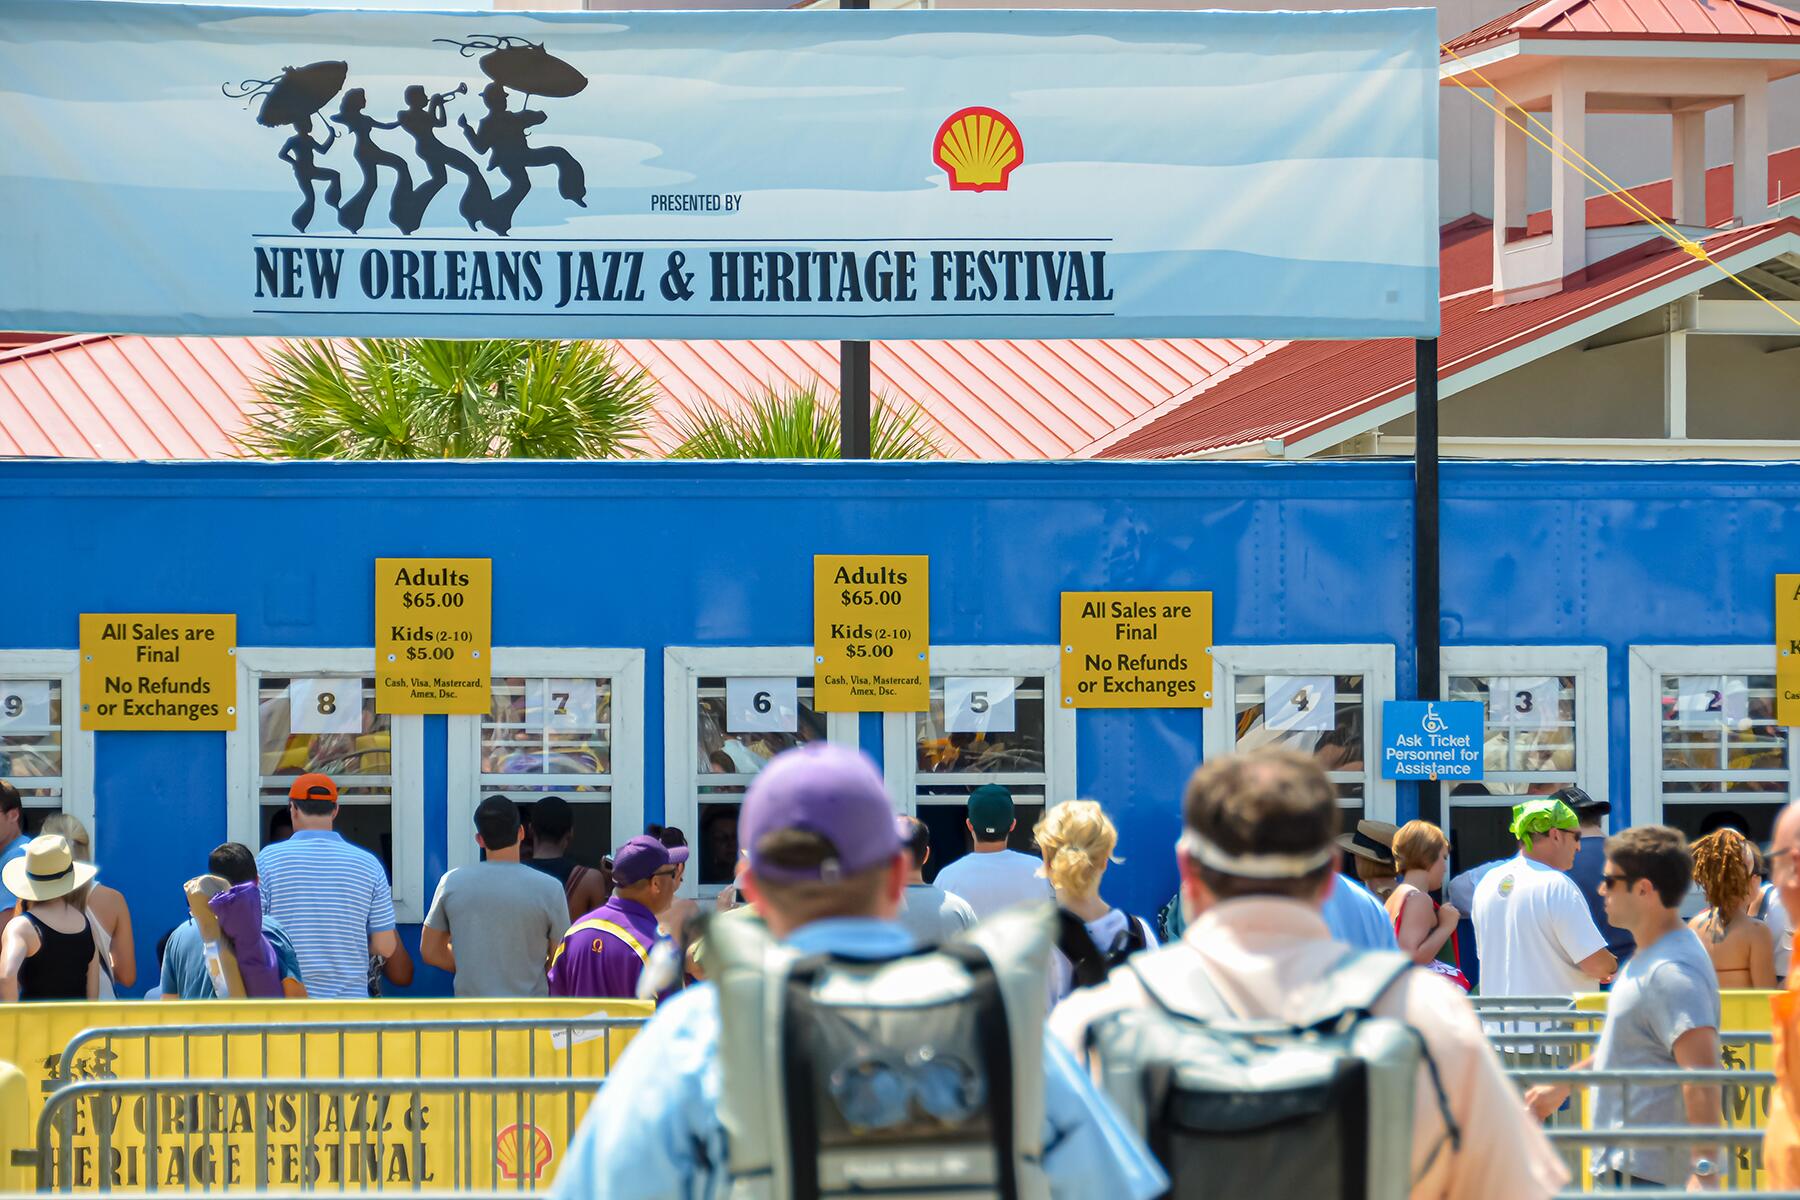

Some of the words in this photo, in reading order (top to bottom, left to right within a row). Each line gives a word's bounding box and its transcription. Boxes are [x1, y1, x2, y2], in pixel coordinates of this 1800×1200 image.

[651, 194, 721, 212] PRESENTED
[725, 194, 743, 212] BY
[254, 246, 345, 300] NEW
[360, 249, 543, 302] ORLEANS
[555, 251, 645, 309] JAZZ
[660, 250, 695, 302] &
[709, 251, 917, 303] HERITAGE
[931, 250, 1114, 302] FESTIVAL
[394, 567, 470, 587] Adults
[833, 566, 908, 585] Adults
[402, 591, 464, 609] $65.00
[841, 589, 902, 607] $65.00
[1081, 601, 1106, 618] All
[1111, 601, 1157, 618] Sales
[1162, 606, 1192, 618] are
[101, 623, 127, 641] All
[132, 623, 179, 641] Sales
[184, 628, 215, 641] are
[391, 626, 434, 642] Kids
[435, 630, 473, 643] (2-10)
[831, 624, 873, 640] Kids
[874, 628, 912, 641] (2-10)
[1115, 623, 1157, 640] Final
[136, 645, 180, 662] Final
[406, 646, 455, 662] $5.00
[846, 643, 894, 659] $5.00
[1085, 654, 1112, 671] No
[1117, 653, 1188, 671] Refunds
[105, 676, 133, 694] No
[138, 676, 211, 694] Refunds
[384, 677, 409, 689] Cash,
[411, 677, 432, 689] Visa,
[434, 677, 483, 690] Mastercard,
[824, 675, 849, 686] Cash,
[850, 675, 871, 686] Visa,
[873, 675, 922, 686] Mastercard,
[1077, 680, 1098, 693] or
[1103, 675, 1196, 698] Exchanges
[410, 689, 437, 699] Amex,
[850, 686, 877, 697] Amex,
[1290, 689, 1310, 712] 4
[4, 695, 23, 718] 9
[96, 703, 118, 716] or
[123, 698, 219, 721] Exchanges
[316, 692, 337, 716] 8
[551, 692, 570, 715] 7
[753, 691, 772, 714] 6
[970, 691, 989, 714] 5
[1515, 690, 1533, 713] 3
[1704, 690, 1723, 712] 2
[1396, 734, 1423, 747] Ask
[1427, 733, 1471, 747] Ticket
[1386, 747, 1455, 761] Personnel
[1460, 748, 1480, 761] for
[1395, 762, 1472, 775] Assistance
